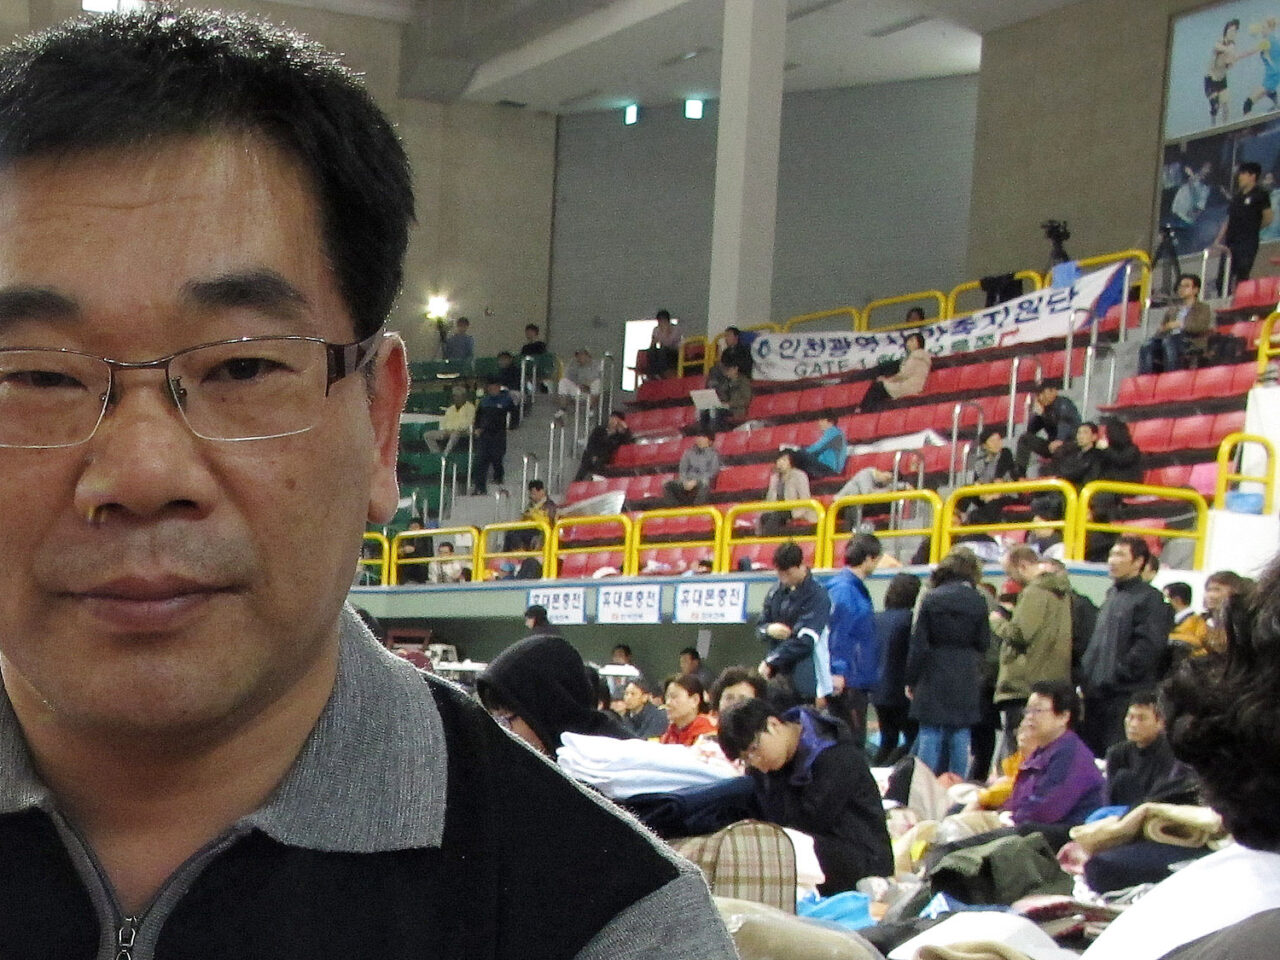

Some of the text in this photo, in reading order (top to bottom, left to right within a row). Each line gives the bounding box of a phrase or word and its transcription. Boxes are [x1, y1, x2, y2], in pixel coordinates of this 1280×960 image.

[794, 358, 850, 379] GATE
[603, 591, 656, 609] 휴대폰충전
[681, 587, 740, 607] 휴대폰충전
